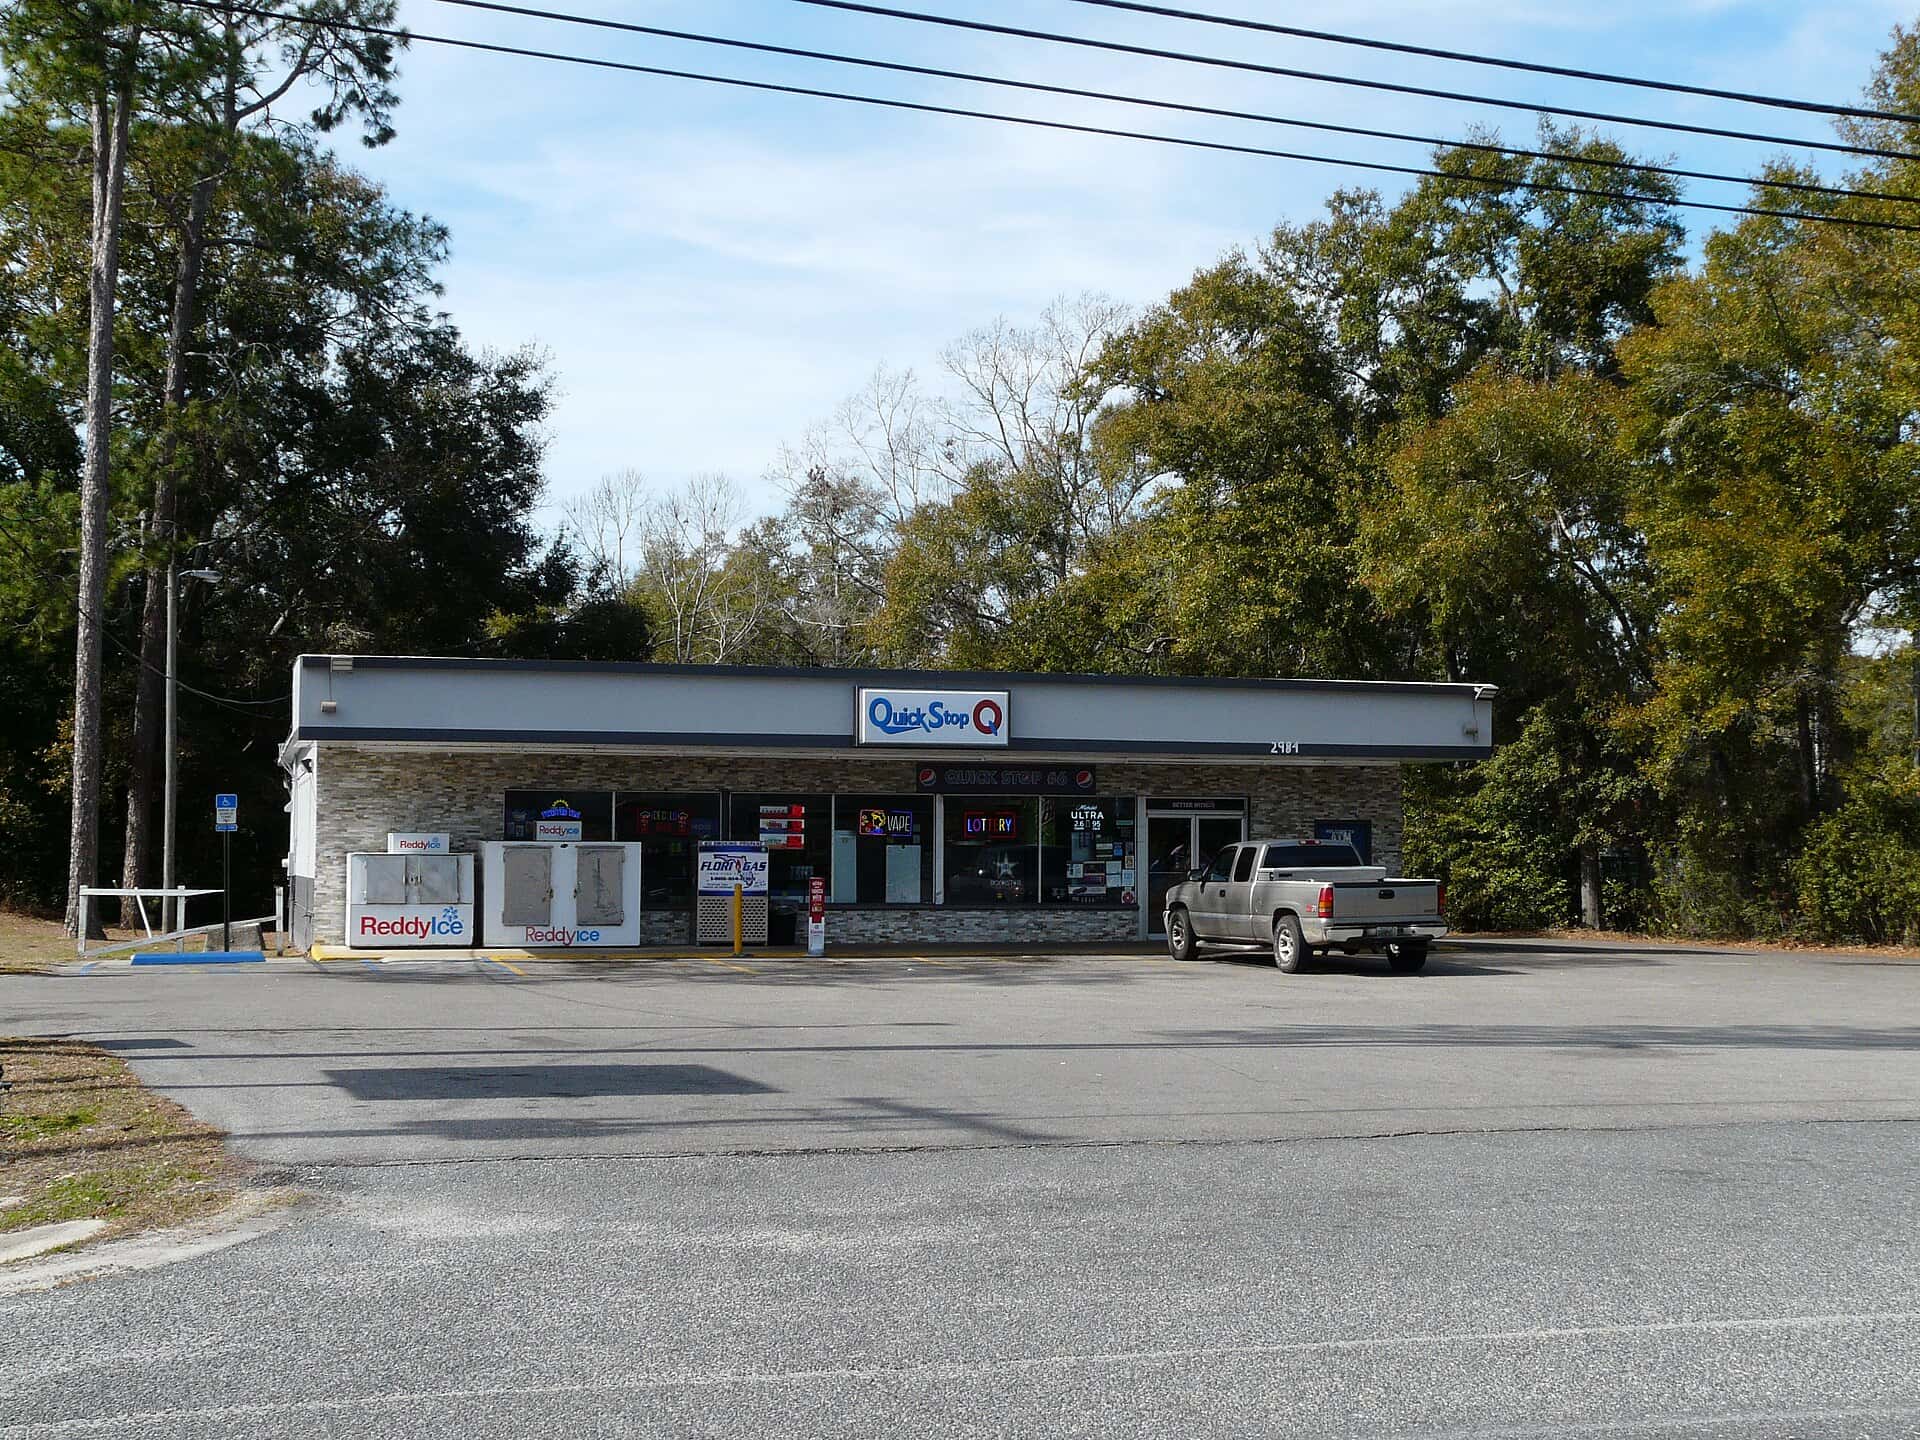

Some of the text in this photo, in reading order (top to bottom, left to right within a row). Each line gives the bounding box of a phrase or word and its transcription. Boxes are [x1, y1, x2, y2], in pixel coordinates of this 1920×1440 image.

[869, 698, 1002, 736] Quick Stop Q
[944, 769, 998, 785] QUICK
[1001, 770, 1042, 785] STOP
[887, 815, 910, 832] VAPE
[1071, 811, 1104, 820] ULTRA
[967, 818, 1012, 832] LOTTERY
